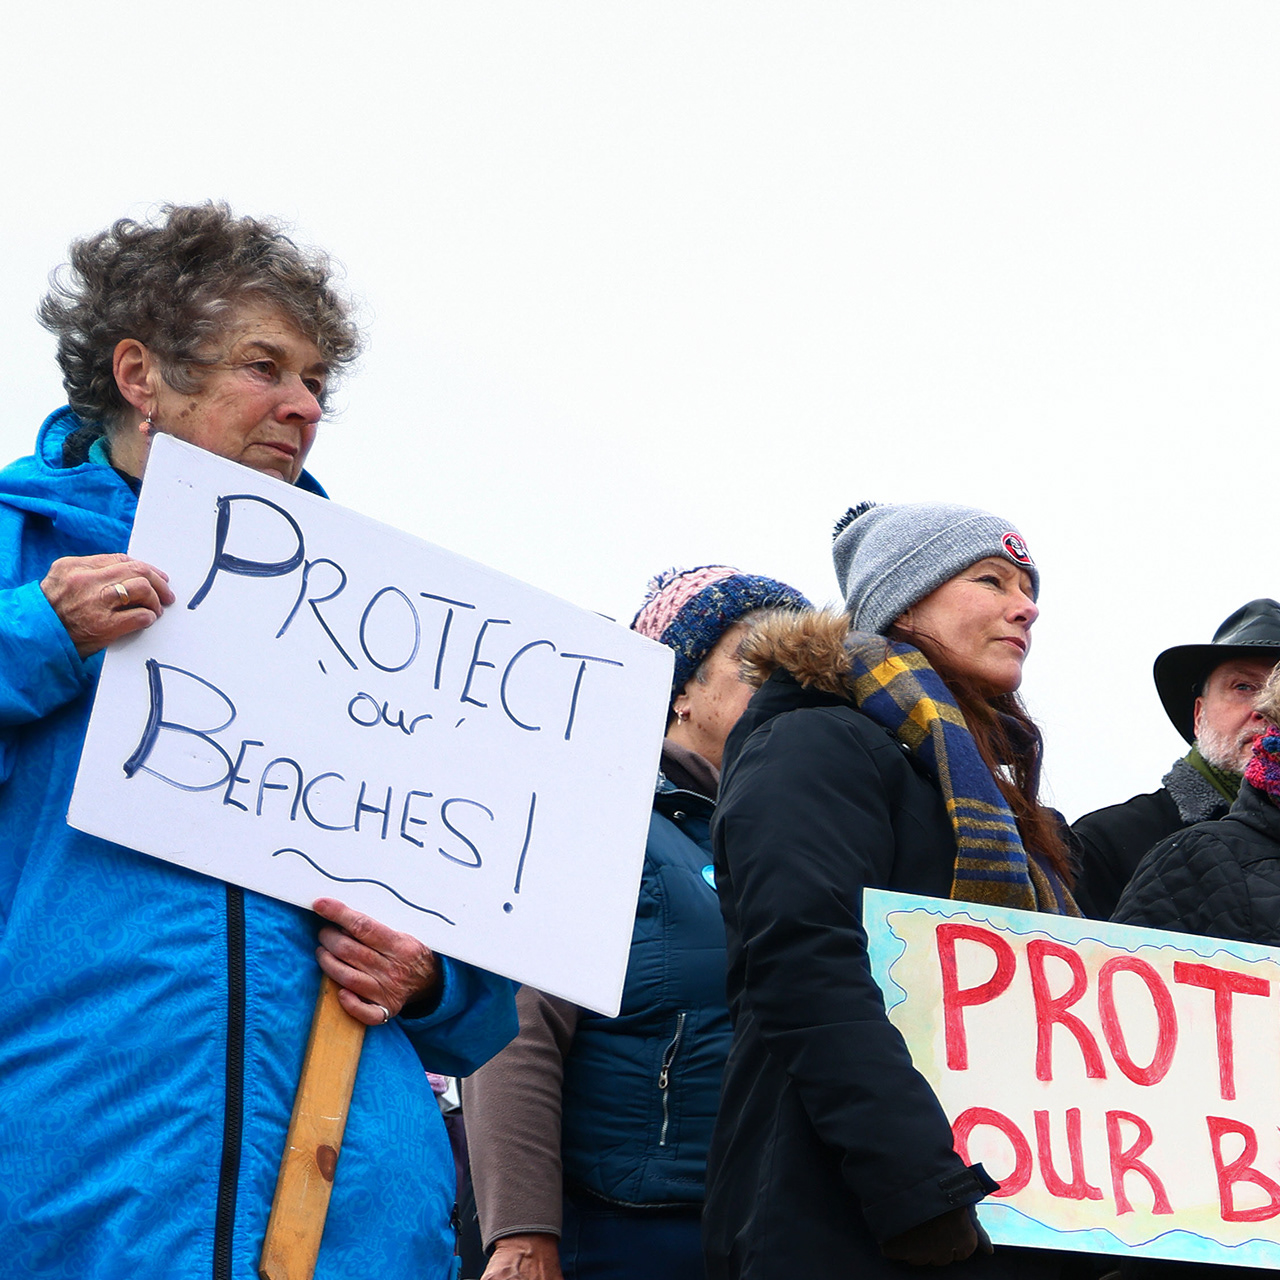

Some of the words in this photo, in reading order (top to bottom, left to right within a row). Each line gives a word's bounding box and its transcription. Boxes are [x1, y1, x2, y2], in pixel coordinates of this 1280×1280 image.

[188, 494, 624, 741] PROTECT
[123, 658, 537, 914] BEACHES!
[347, 691, 433, 735] our
[951, 1106, 1173, 1216] OUR
